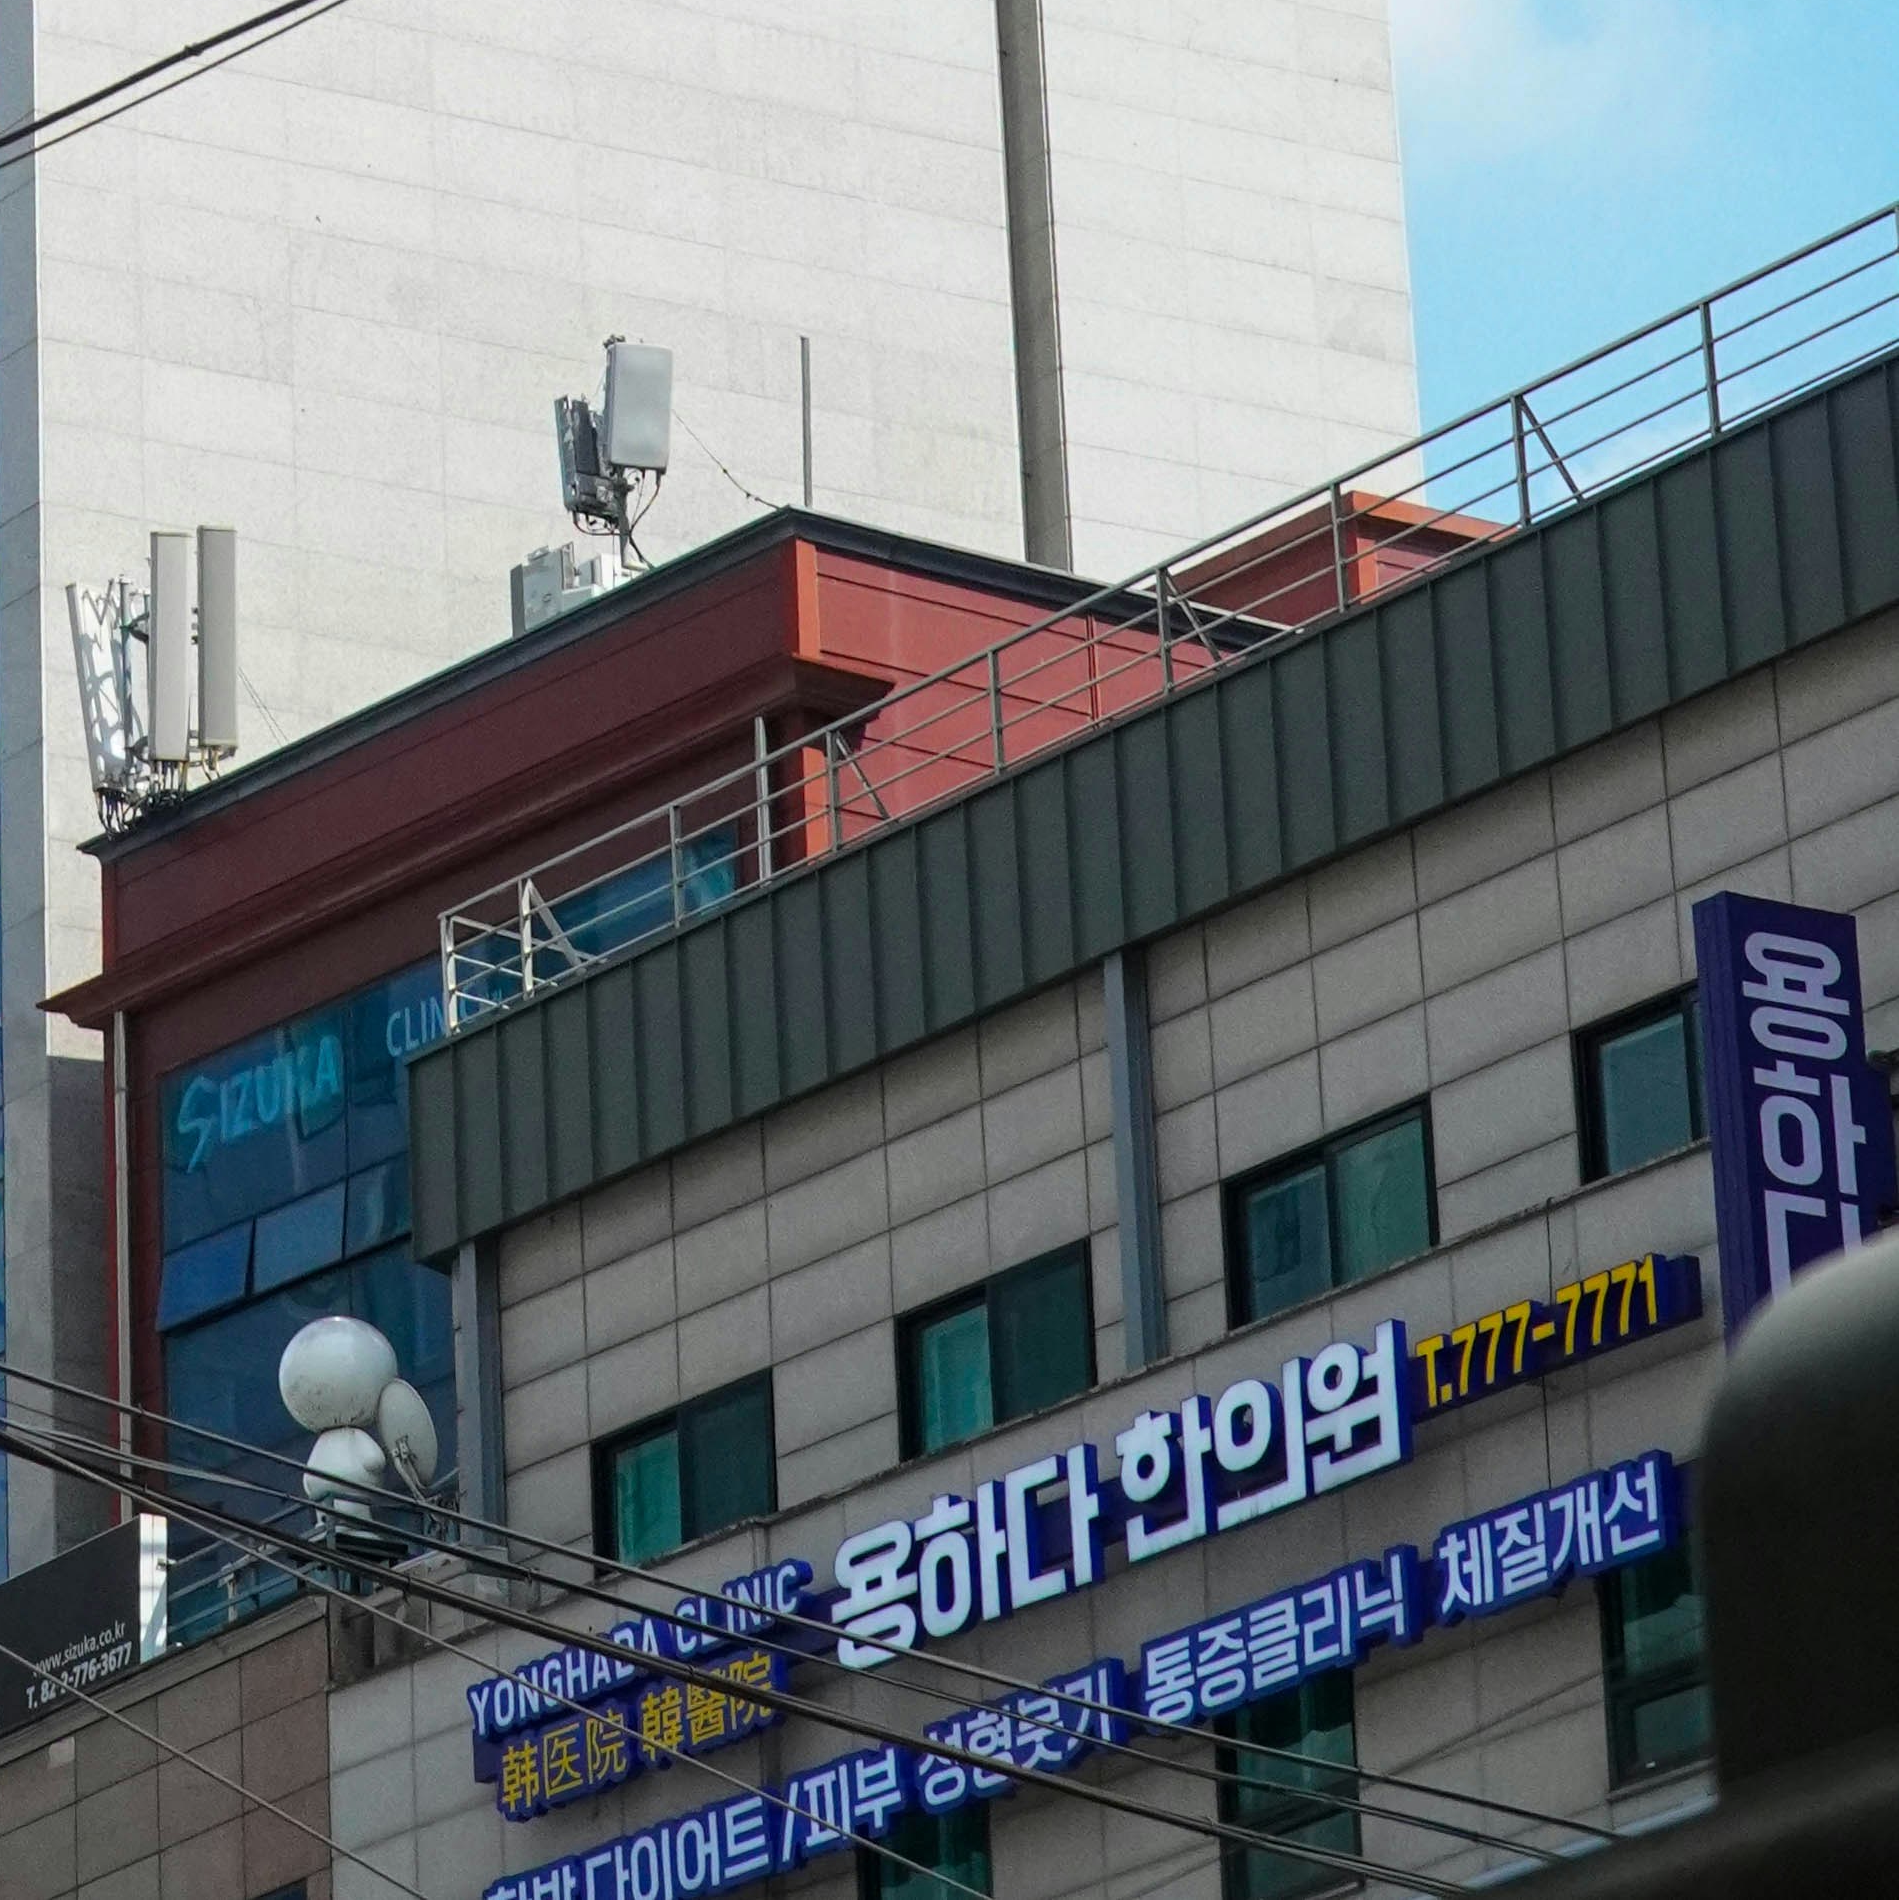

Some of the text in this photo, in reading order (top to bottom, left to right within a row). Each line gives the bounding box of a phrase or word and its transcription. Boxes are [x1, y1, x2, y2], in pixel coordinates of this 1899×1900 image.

[386, 985, 476, 1056] CLINC
[832, 1254, 1659, 1668] 용하다 한의원 T.777-7771
[471, 1565, 797, 1736] YONGHADA CLINIC
[919, 1668, 1111, 1806] 성형붓기
[1144, 1555, 1407, 1725] 통증클리닉
[1439, 1464, 1661, 1616] 체질개선
